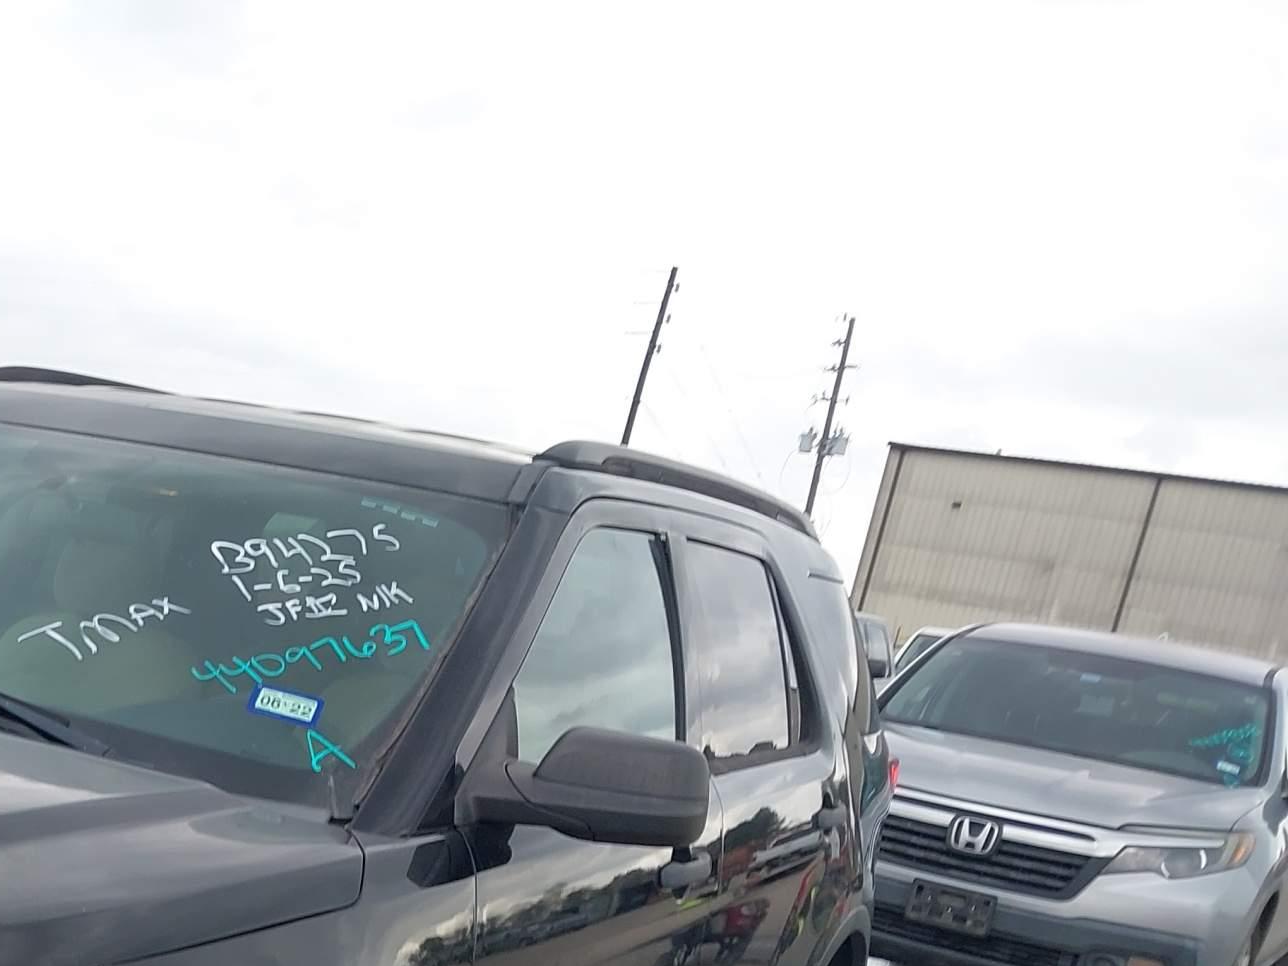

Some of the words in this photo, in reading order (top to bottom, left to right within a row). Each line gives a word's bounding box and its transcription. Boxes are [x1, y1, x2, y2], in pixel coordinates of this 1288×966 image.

[231, 558, 361, 601] 1-6-25
[17, 596, 192, 660] TMAX
[191, 619, 430, 694] 44097637
[306, 728, 357, 773] A
